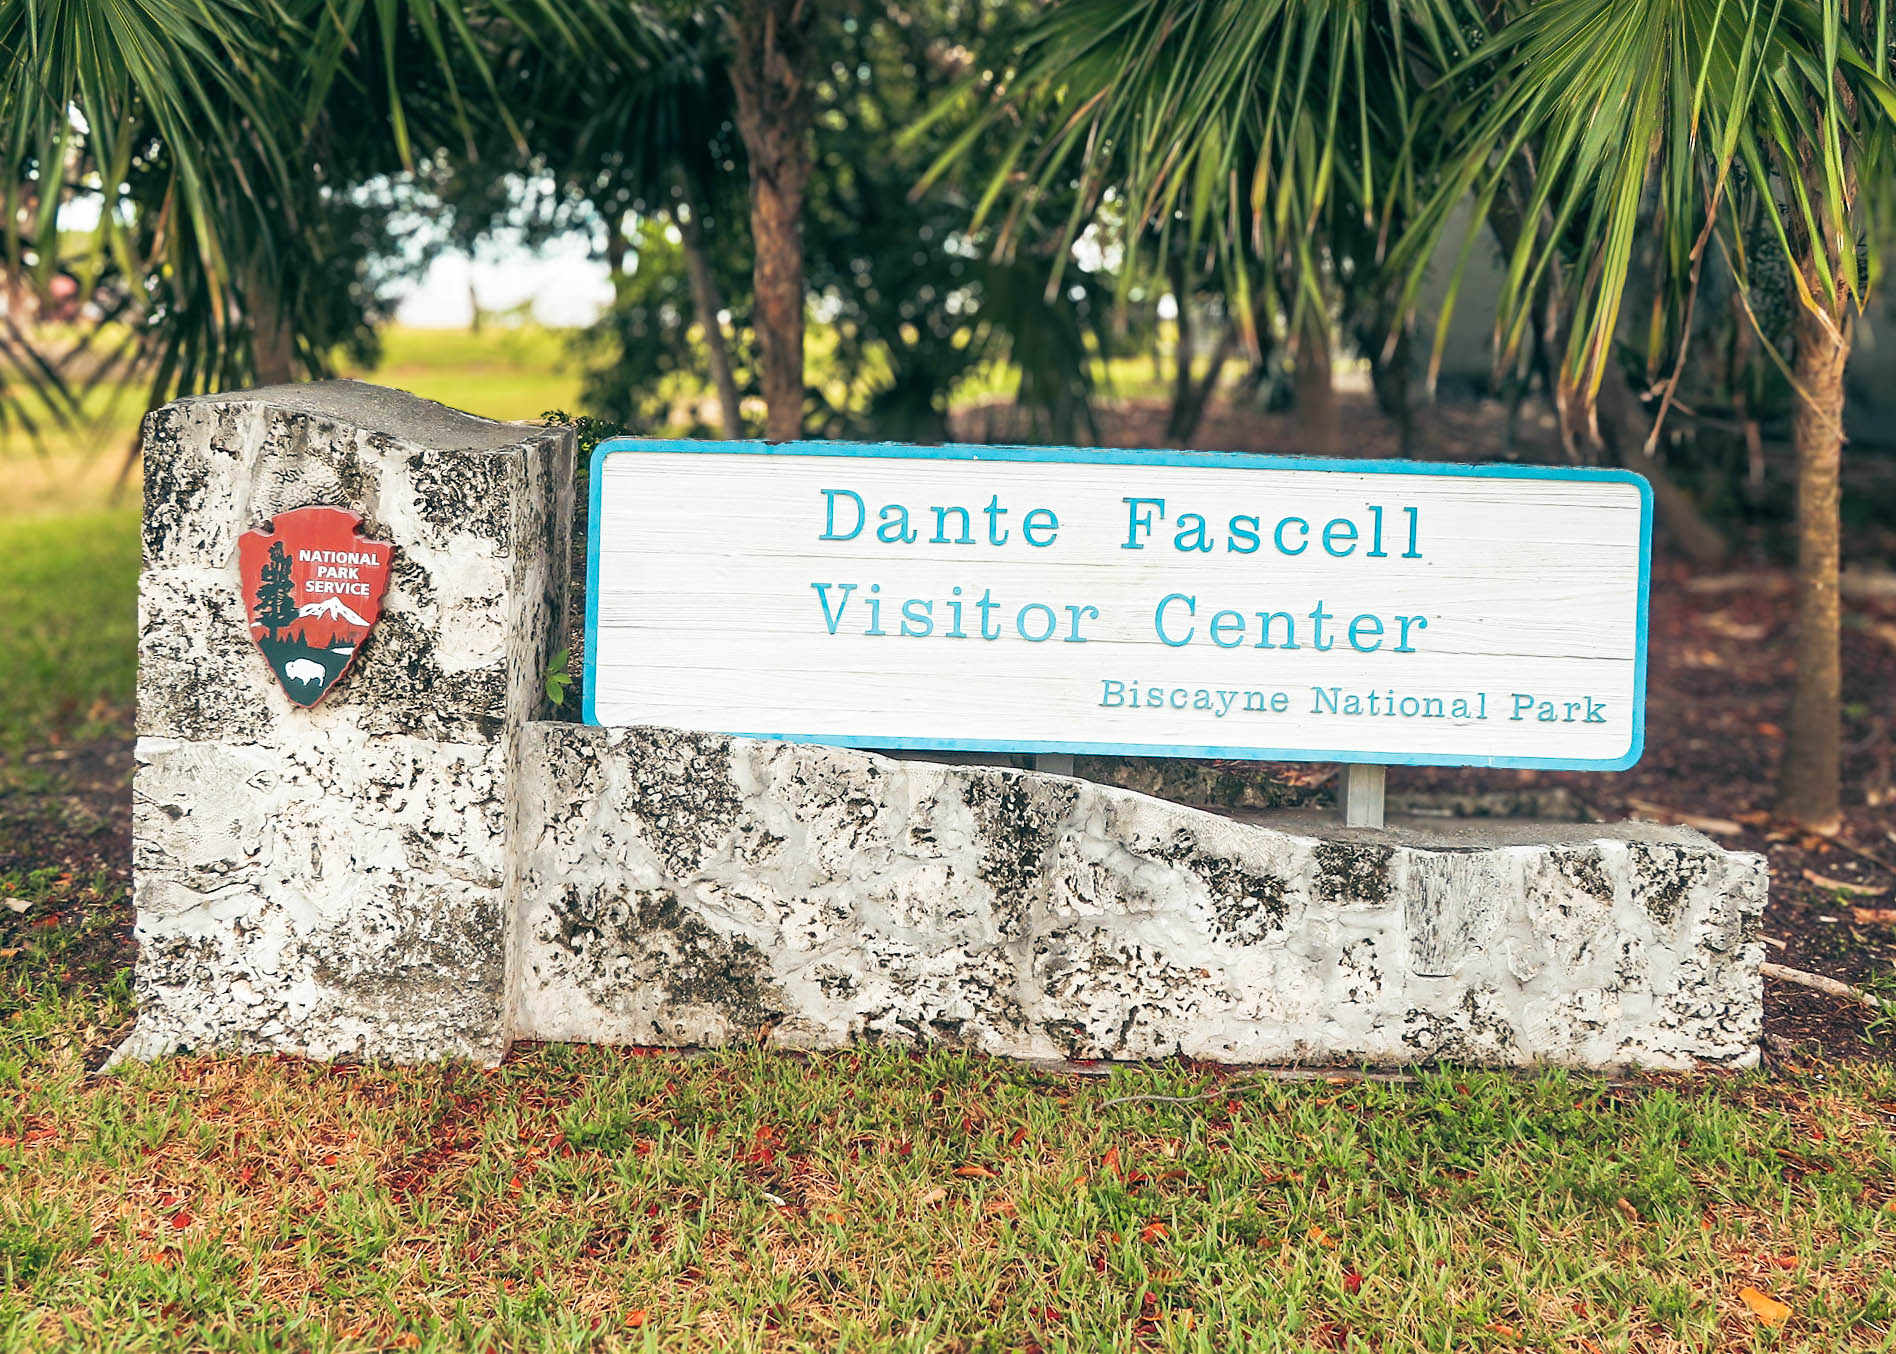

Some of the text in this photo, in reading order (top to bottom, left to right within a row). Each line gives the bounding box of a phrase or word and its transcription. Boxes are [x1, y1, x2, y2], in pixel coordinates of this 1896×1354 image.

[819, 488, 1424, 559] Dante Fascell
[298, 549, 381, 567] NATIONAL
[317, 566, 359, 580] PARK
[305, 580, 370, 596] SERVICE
[810, 582, 1429, 653] Visitor Center
[1099, 679, 1607, 724] Biscayne National Park
